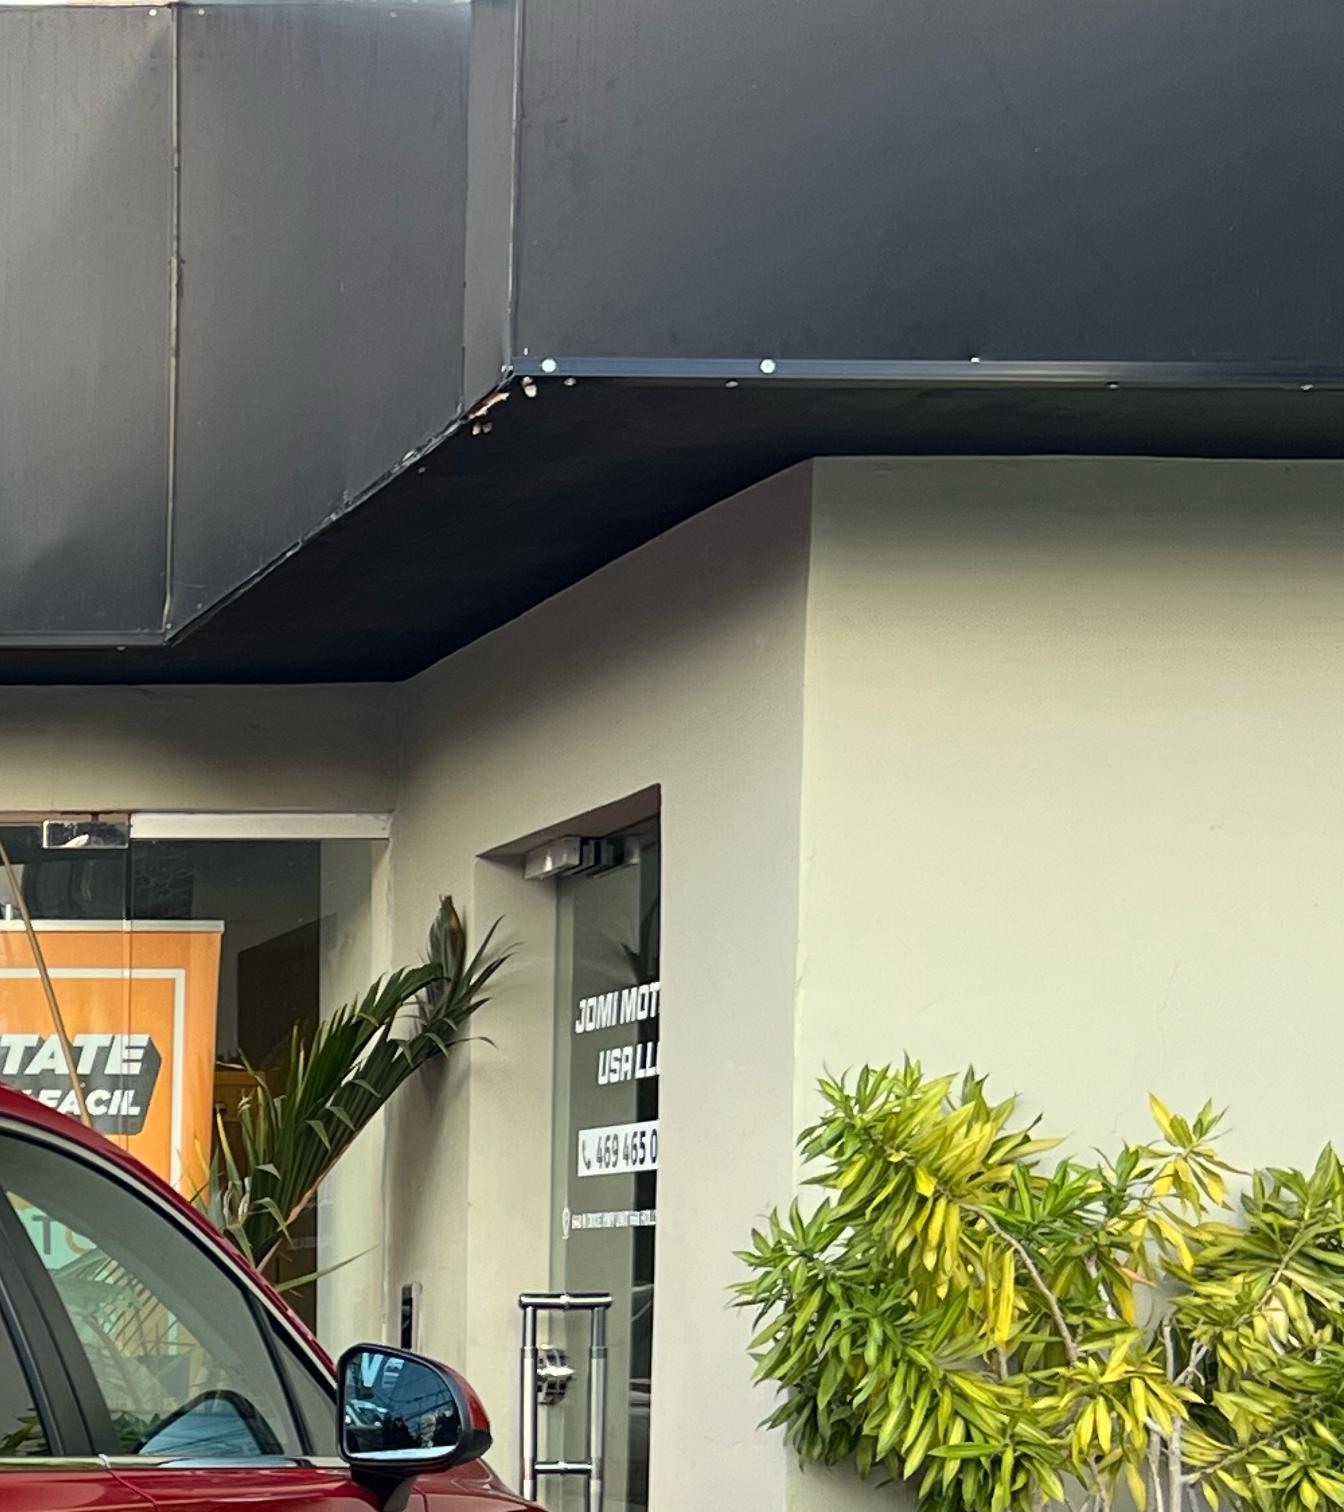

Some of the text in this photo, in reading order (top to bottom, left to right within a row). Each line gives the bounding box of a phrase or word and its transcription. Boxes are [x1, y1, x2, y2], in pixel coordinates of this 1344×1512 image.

[575, 981, 660, 1034] JOMI MOT
[598, 1042, 660, 1085] USA LL
[596, 1134, 619, 1169] 469
[623, 1131, 646, 1166] 465
